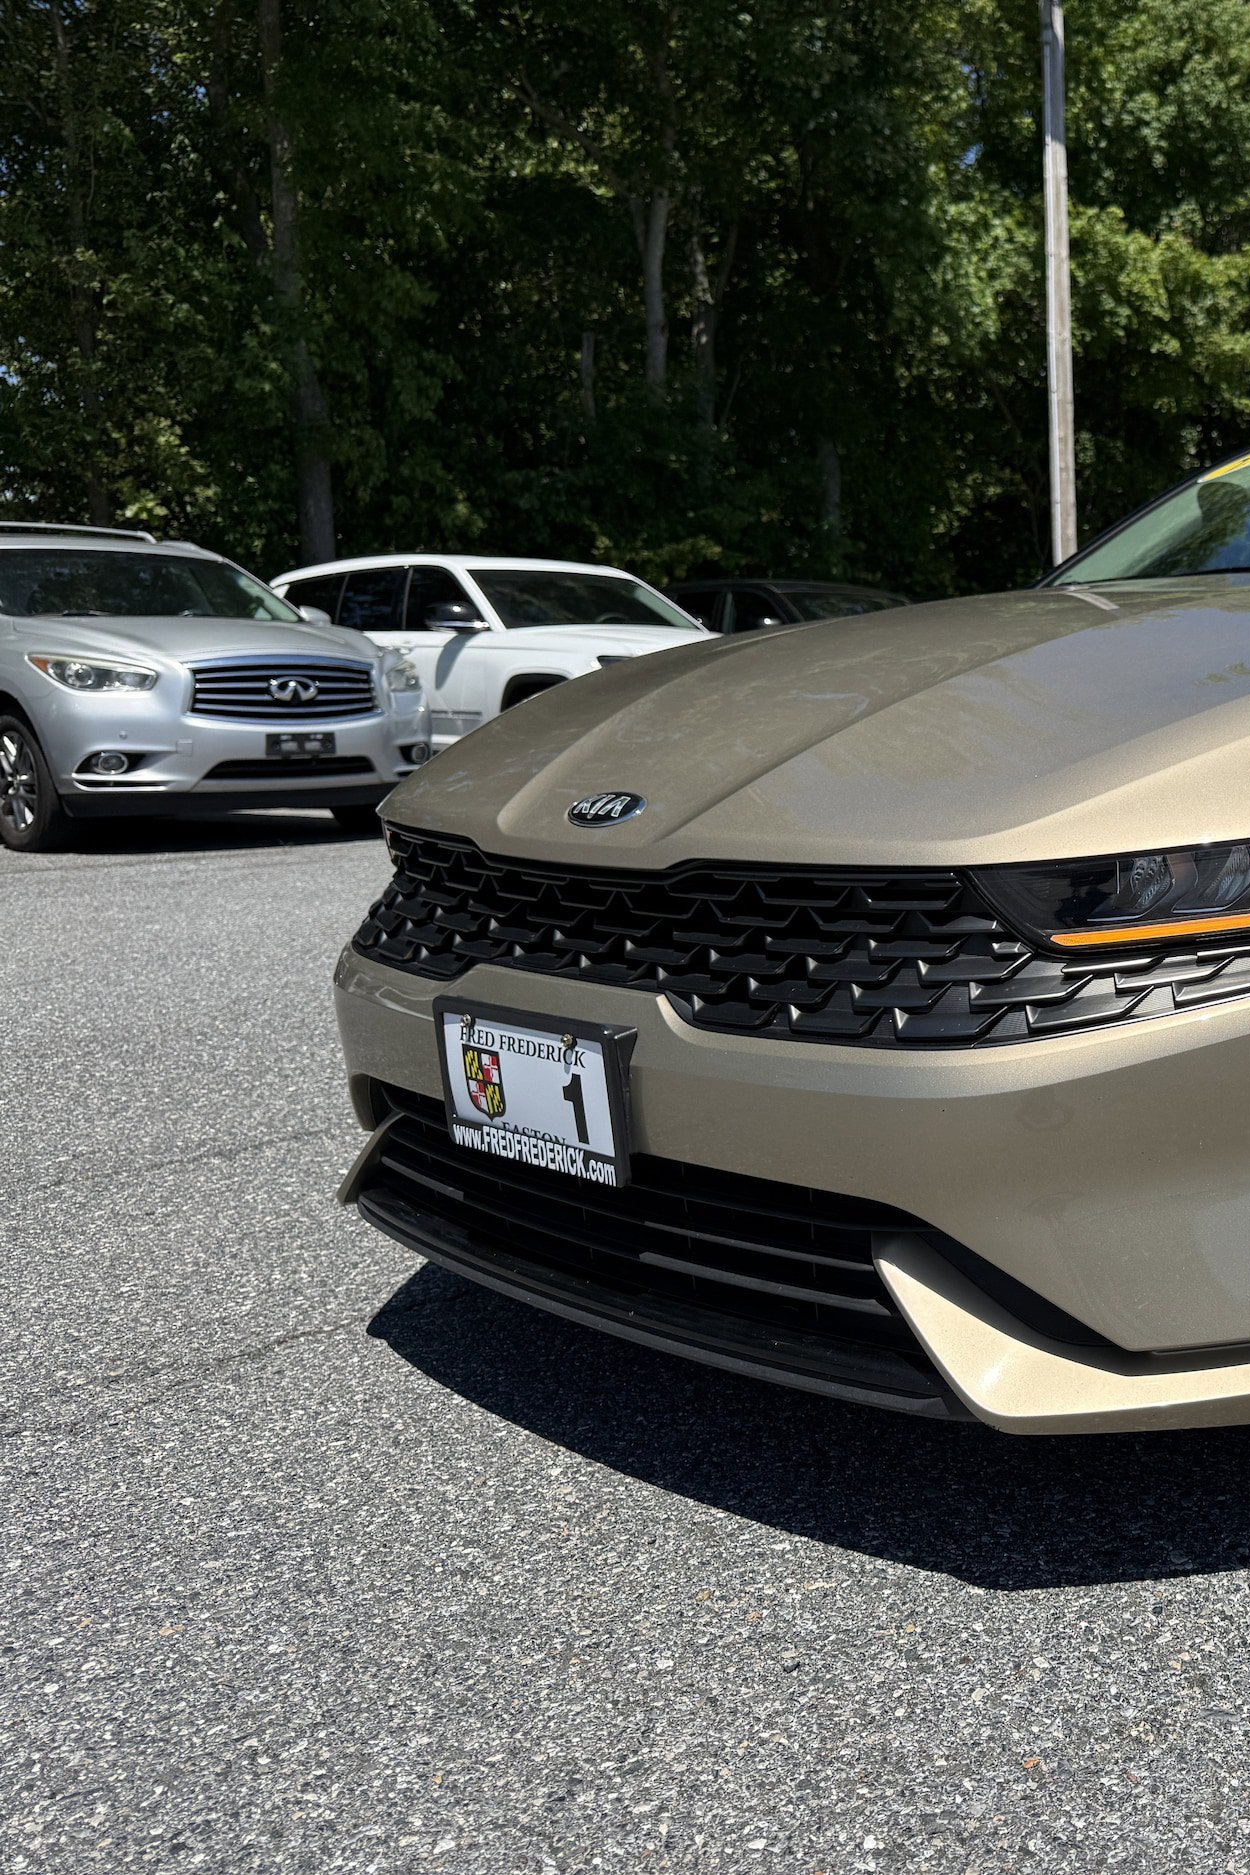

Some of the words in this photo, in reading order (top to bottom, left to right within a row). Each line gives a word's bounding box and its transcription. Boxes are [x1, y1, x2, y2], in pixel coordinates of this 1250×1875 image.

[572, 794, 632, 819] KIA
[459, 1025, 496, 1048] FRED
[499, 1033, 587, 1069] FREDERICK
[561, 1072, 590, 1145] 1
[452, 1123, 617, 1188] www.FREDFREDERICK.com
